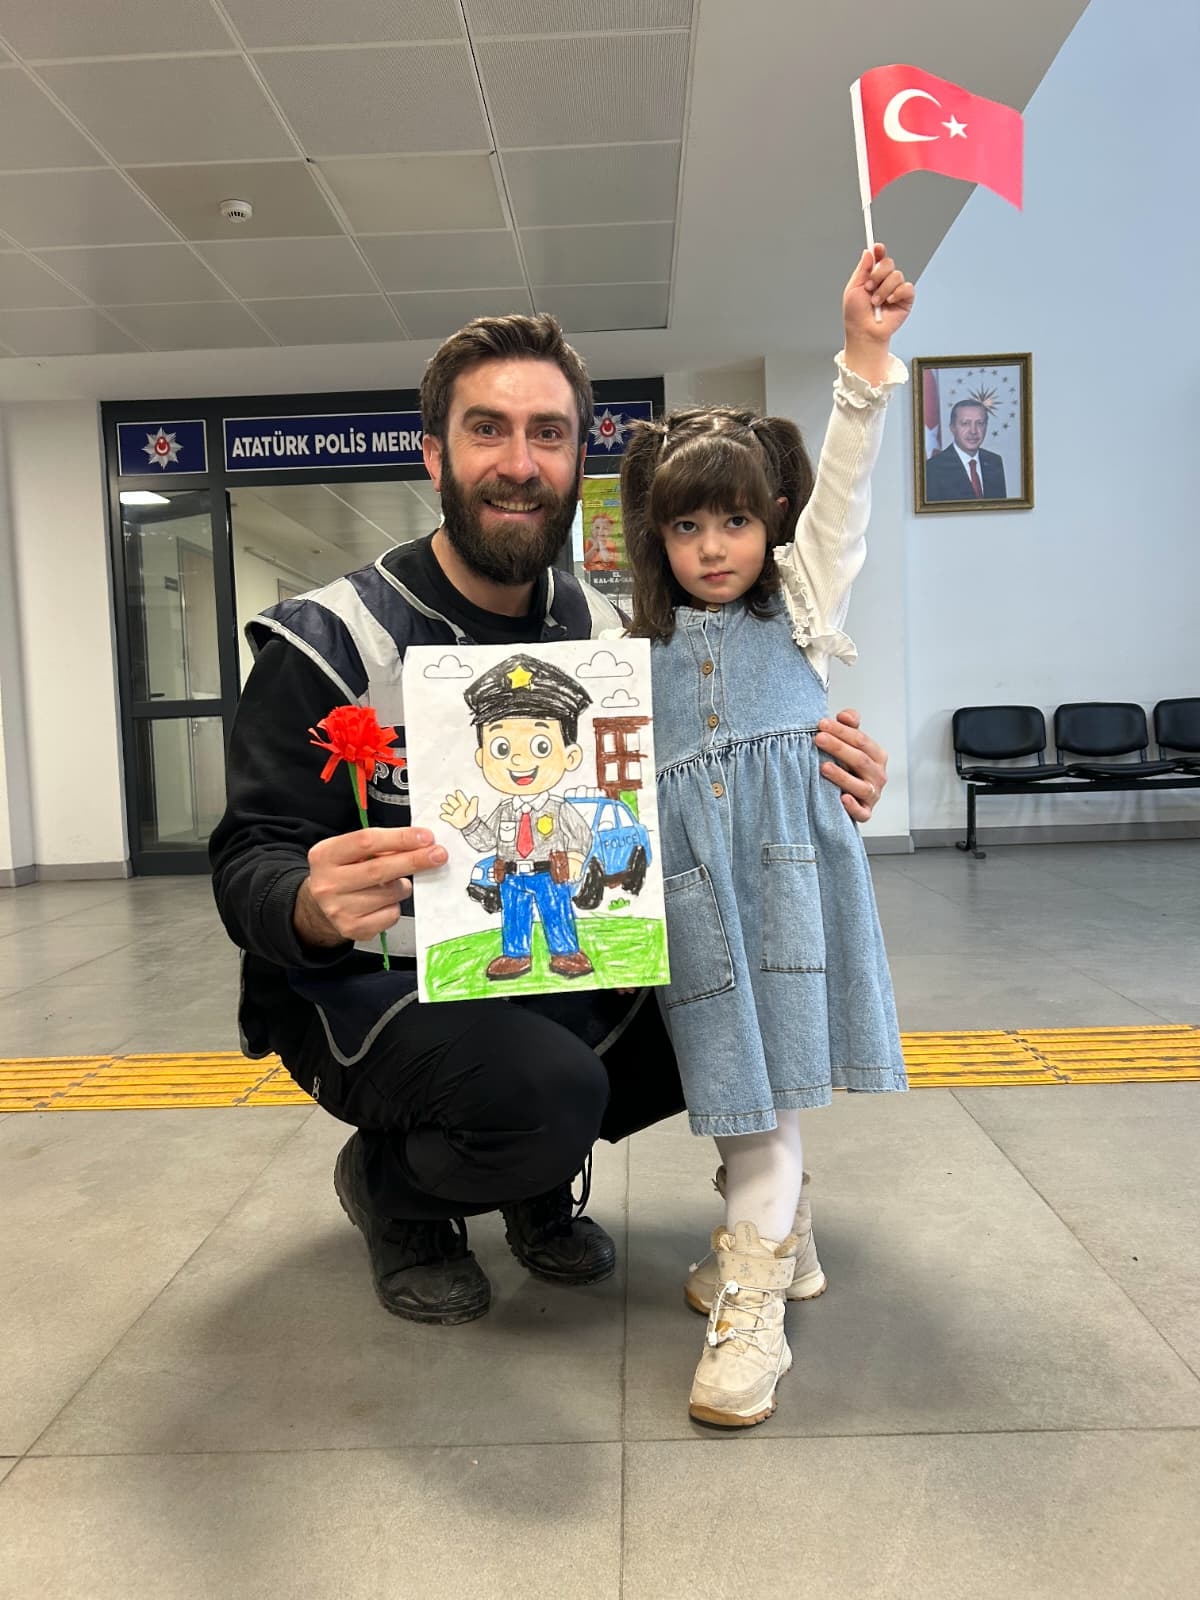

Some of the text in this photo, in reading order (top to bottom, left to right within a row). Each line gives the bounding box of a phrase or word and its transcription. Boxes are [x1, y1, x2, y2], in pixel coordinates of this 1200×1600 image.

[232, 427, 423, 458] ATATÜRK POLİS MERK
[604, 833, 639, 848] POLICE
